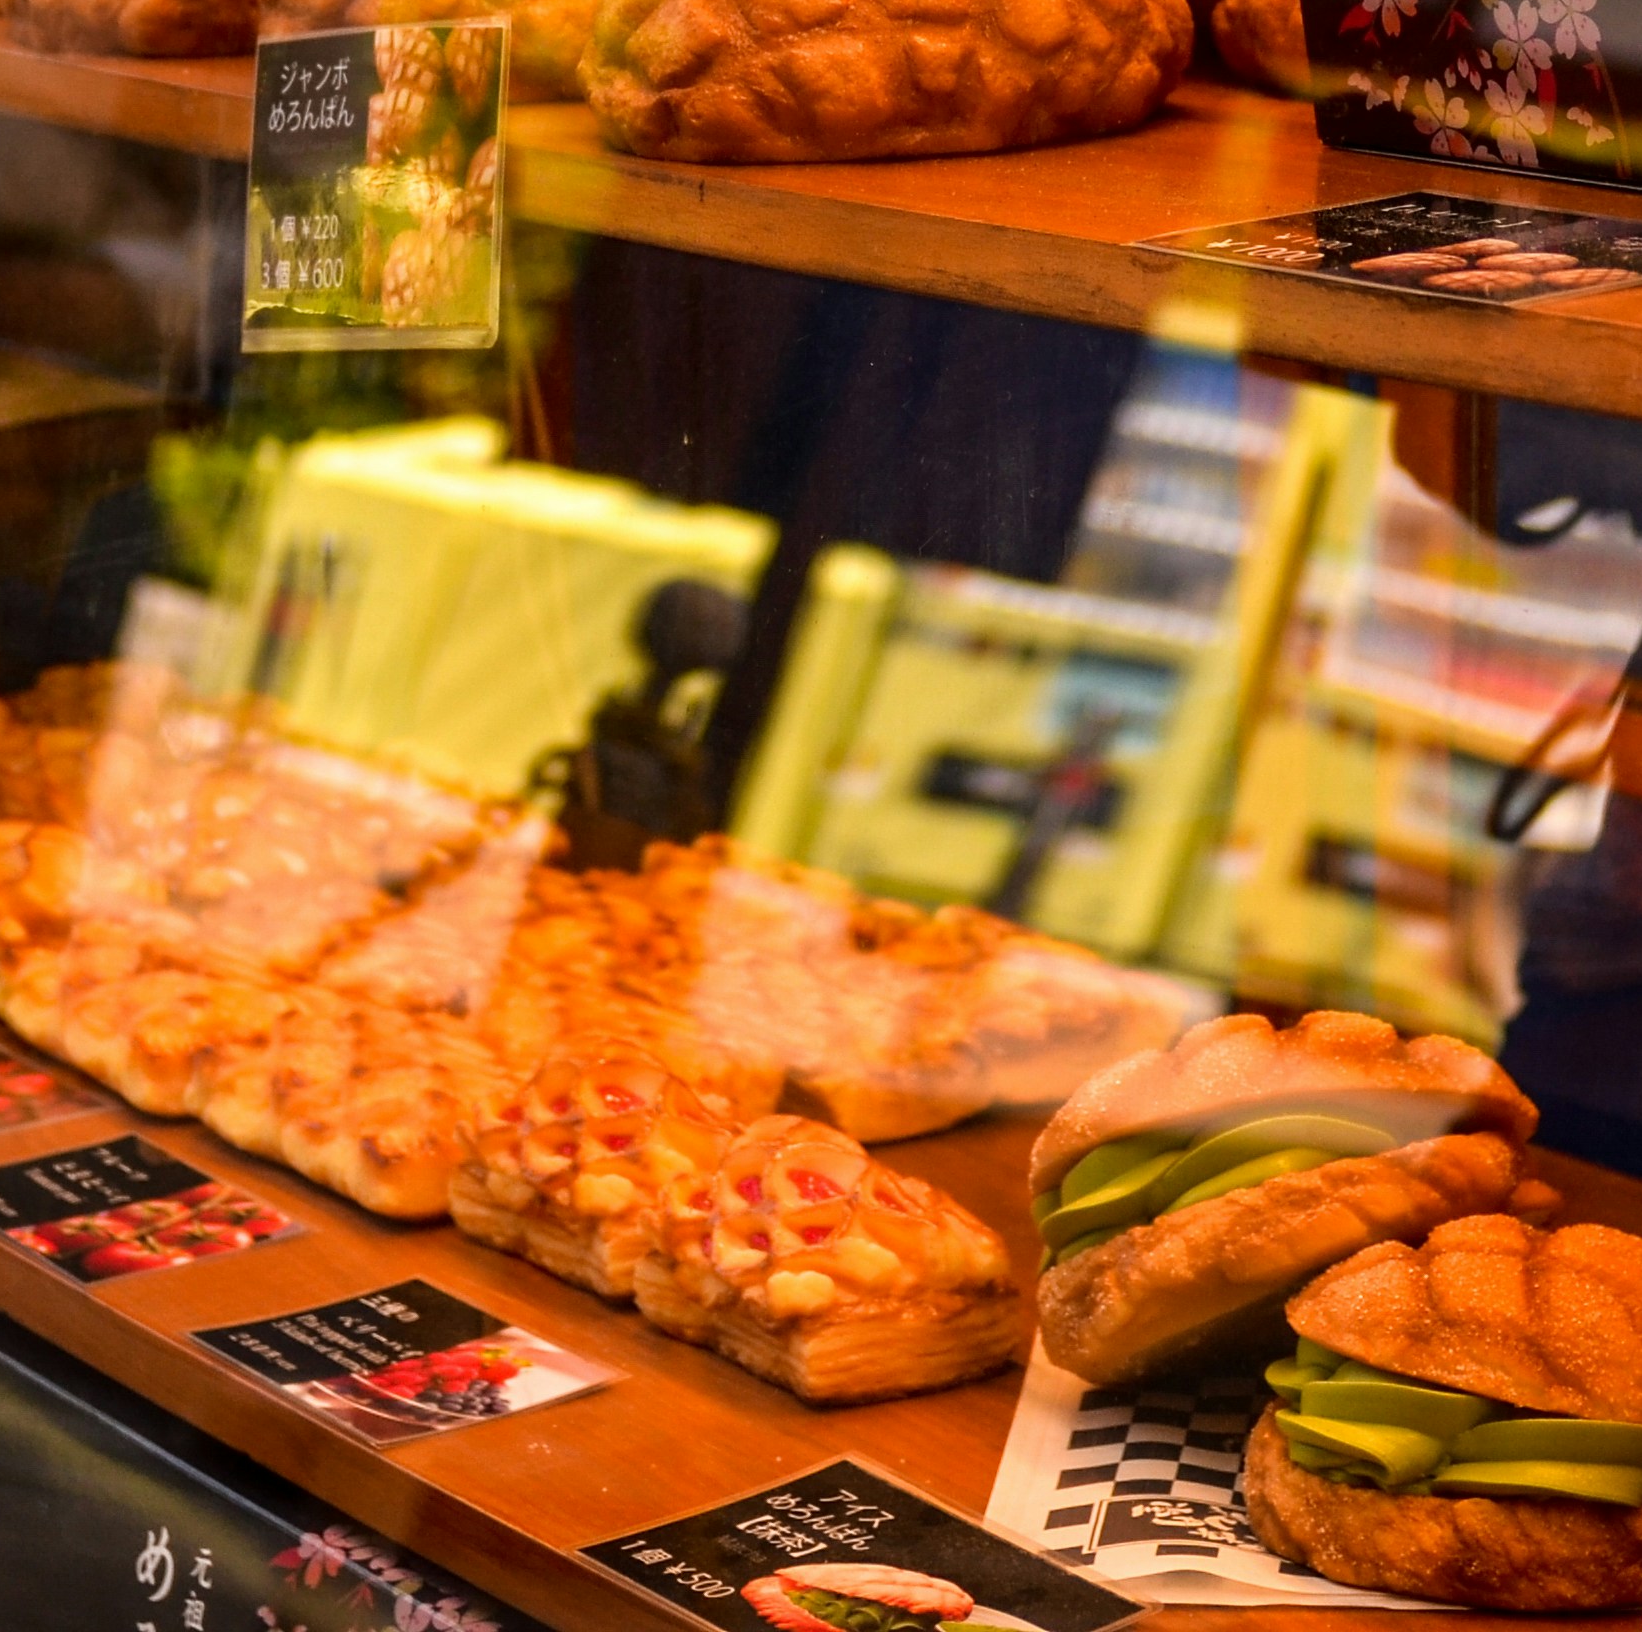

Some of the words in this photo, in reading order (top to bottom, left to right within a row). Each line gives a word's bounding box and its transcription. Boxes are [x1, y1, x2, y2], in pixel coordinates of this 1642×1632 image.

[279, 56, 351, 95] ジャンボ
[268, 94, 355, 133] めろんぱん
[1205, 237, 1325, 263] ¥1000
[765, 1493, 876, 1552] めろんぱん
[818, 1487, 896, 1528] アイス
[735, 1514, 828, 1558] 【抹茶】
[135, 1525, 176, 1632] め
[182, 1547, 215, 1632] 元祖
[662, 1561, 736, 1599] ¥500
